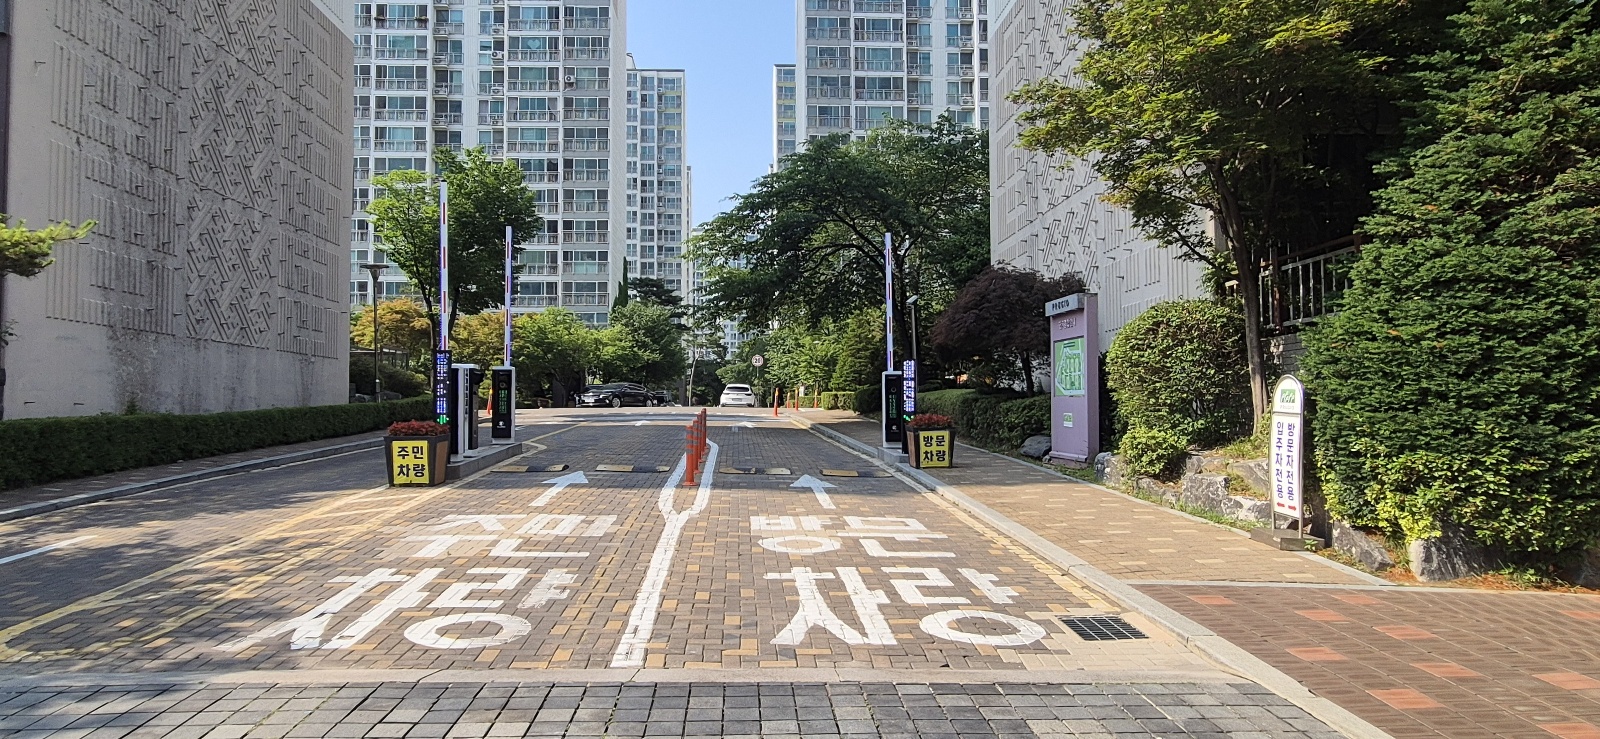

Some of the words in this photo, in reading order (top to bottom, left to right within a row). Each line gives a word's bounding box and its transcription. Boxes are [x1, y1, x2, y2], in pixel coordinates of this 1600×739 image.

[397, 446, 424, 460] 주민
[923, 435, 945, 447] 방문
[923, 450, 946, 462] 차량
[1276, 422, 1284, 498] 입주자전용
[1286, 422, 1295, 501] 방문자전용
[397, 463, 426, 478] 차량
[403, 514, 617, 558] 주민
[750, 515, 956, 558] 방문
[213, 567, 578, 650] 차량
[763, 567, 1046, 646] 차량
